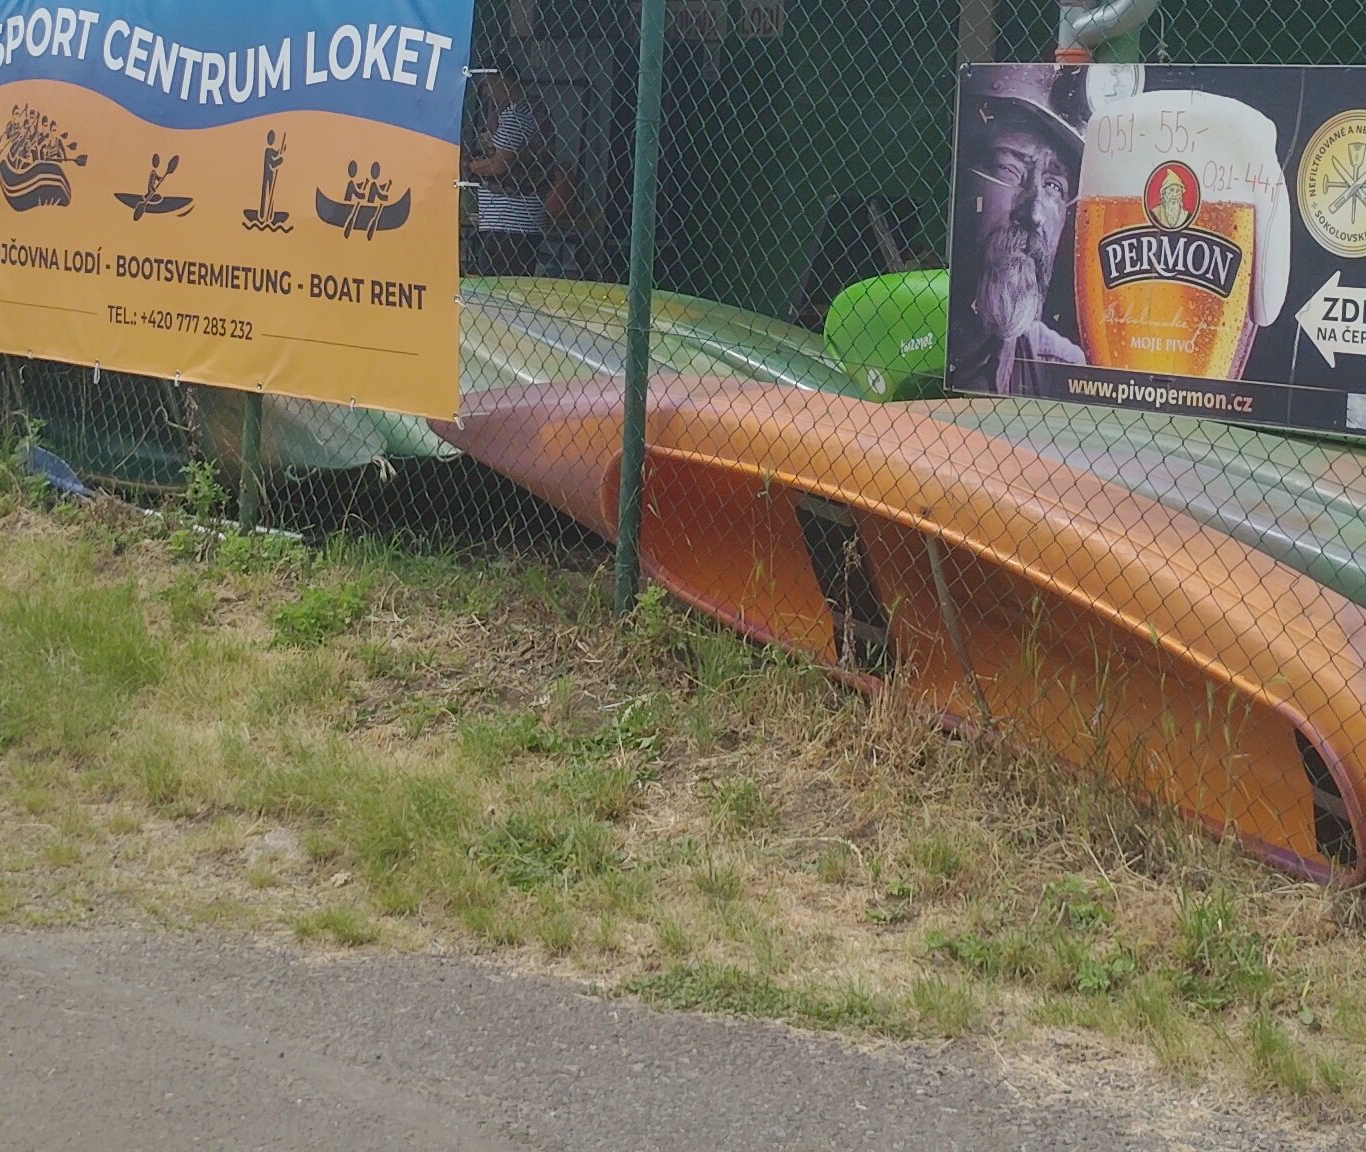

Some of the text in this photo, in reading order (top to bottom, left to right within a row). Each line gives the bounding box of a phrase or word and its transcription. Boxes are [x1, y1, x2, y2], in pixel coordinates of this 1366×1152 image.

[103, 19, 291, 105] CENTRUM
[306, 23, 452, 91] LOKET
[1309, 127, 1346, 198] NEFILTROVANÉ
[1347, 126, 1354, 135] A
[63, 246, 102, 276] LODÍ
[116, 255, 292, 296] BOOTSVERMIETUNG
[310, 273, 365, 303] BOAT
[371, 280, 427, 310] RENT
[1106, 235, 1234, 286] PERMON
[140, 310, 173, 331] +420
[176, 313, 200, 335] 777
[203, 315, 226, 338] 283
[229, 318, 253, 341] 232
[1130, 336, 1196, 354] MOJE PIVO
[1316, 328, 1338, 344] NA
[1068, 376, 1253, 413] www.pivopermon.cz
